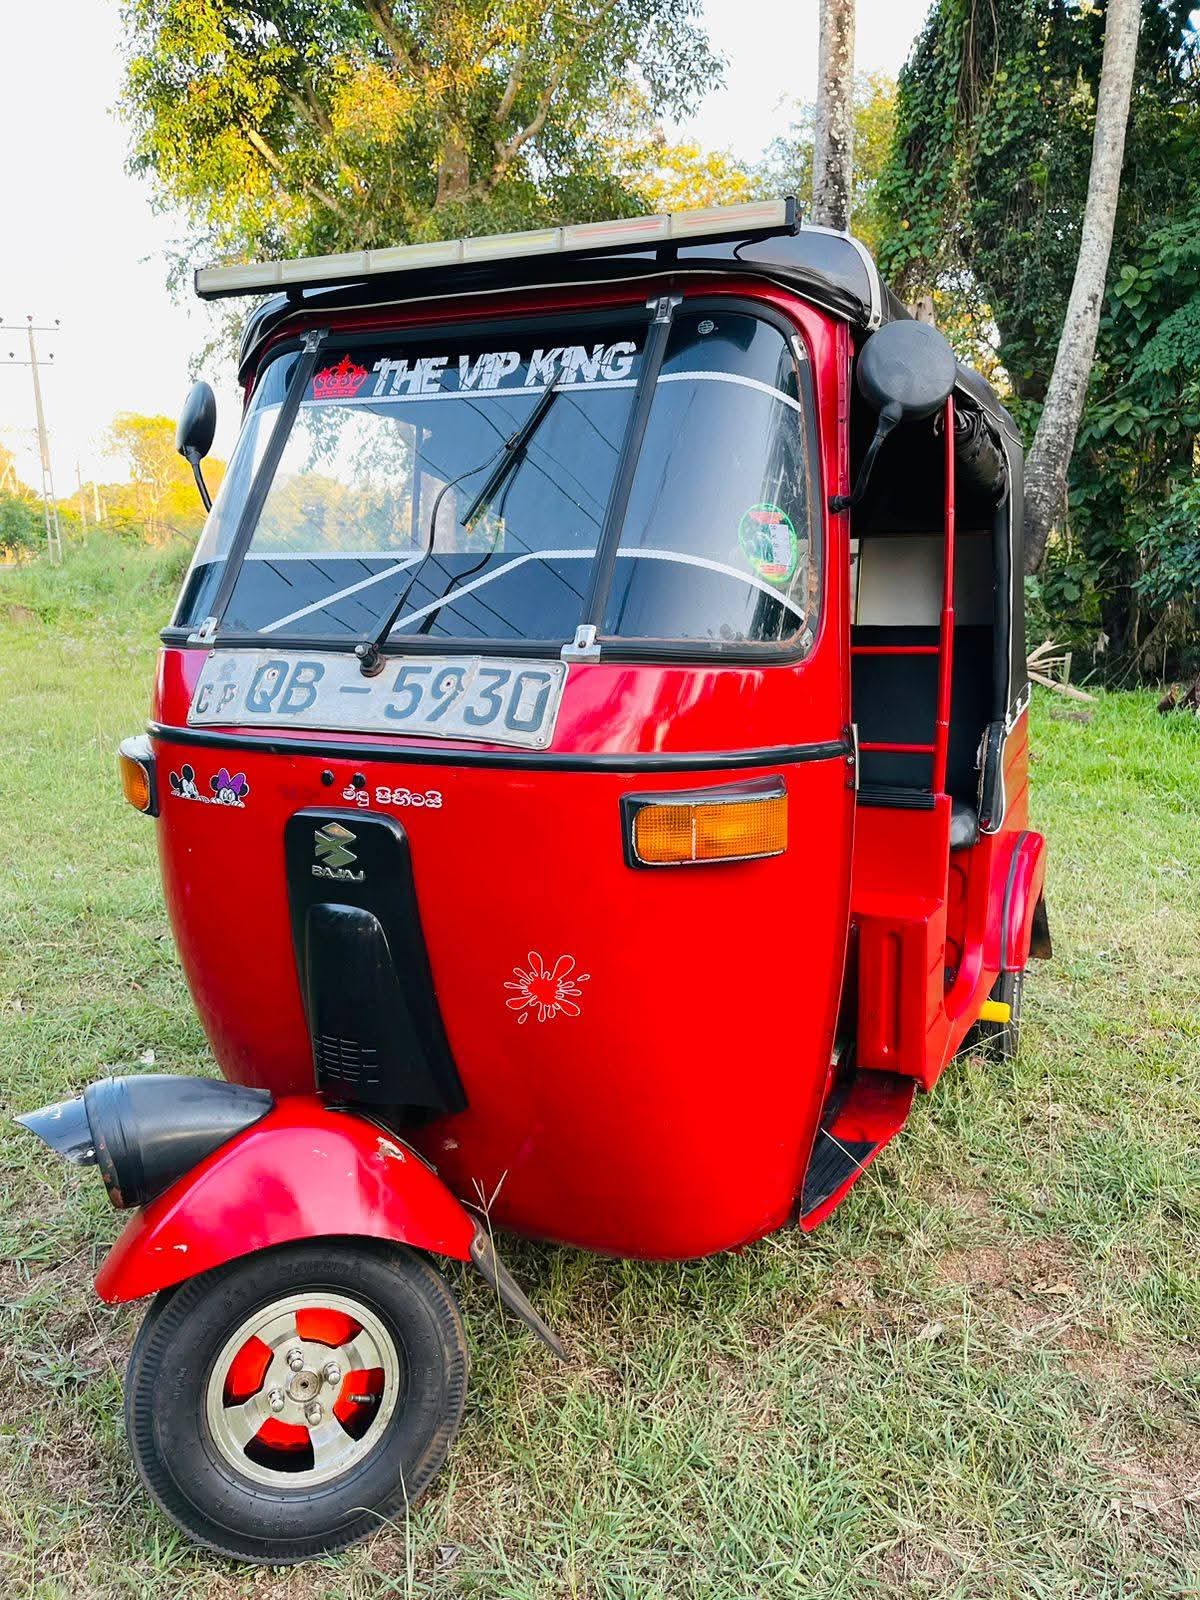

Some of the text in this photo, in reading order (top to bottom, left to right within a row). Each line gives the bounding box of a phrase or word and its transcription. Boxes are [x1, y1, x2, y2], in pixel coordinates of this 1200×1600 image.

[371, 340, 636, 396] THE VIP KING
[311, 864, 367, 882] BAJAJ
